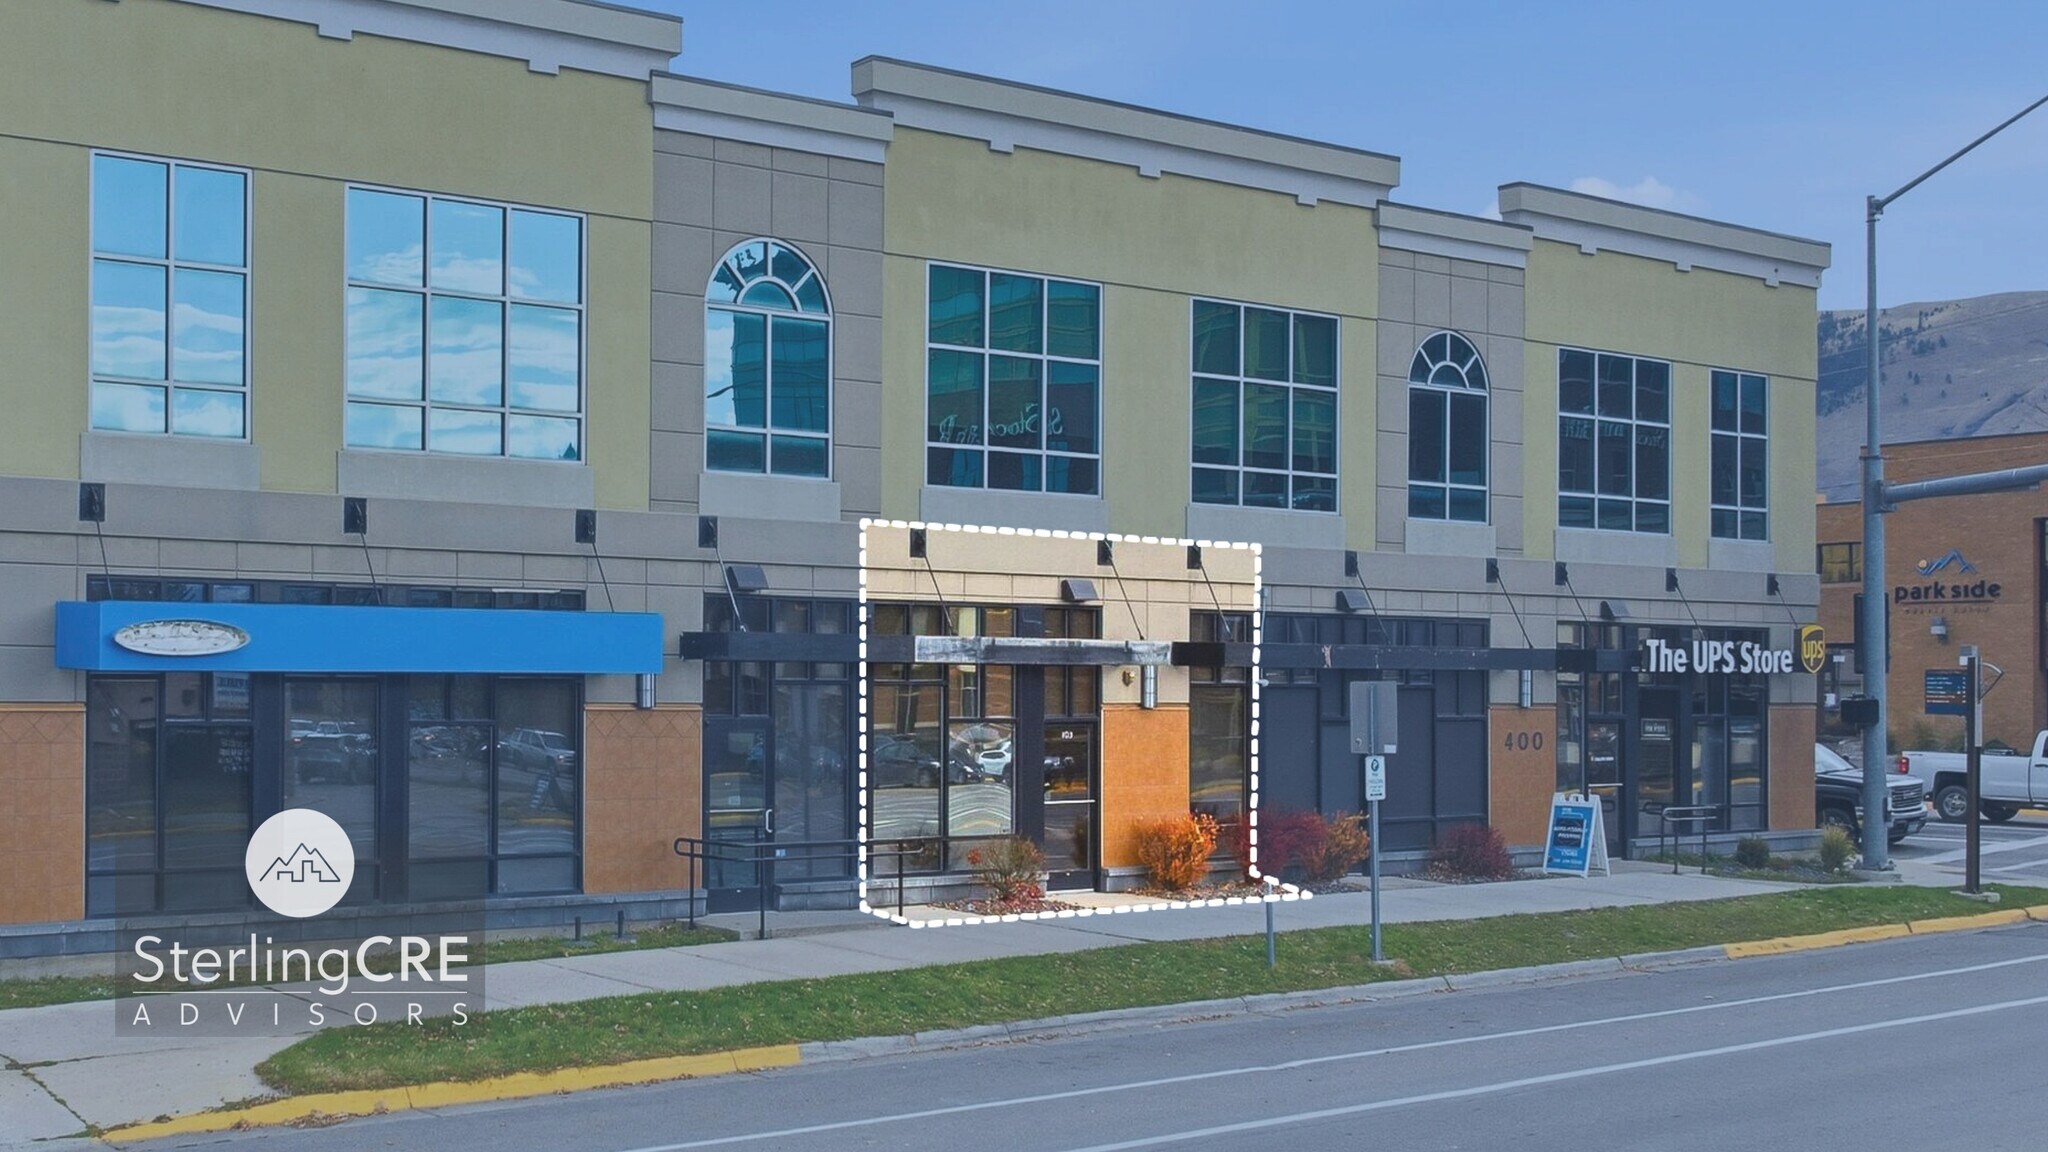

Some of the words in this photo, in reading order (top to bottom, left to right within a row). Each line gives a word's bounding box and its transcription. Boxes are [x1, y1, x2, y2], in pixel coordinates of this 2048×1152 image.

[1894, 581, 1946, 604] park
[1951, 580, 2001, 599] side
[1646, 639, 1688, 673] The
[1693, 640, 1735, 673] UPS
[1740, 641, 1793, 673] Store
[1803, 640, 1824, 666] ups
[1504, 731, 1543, 751] 400
